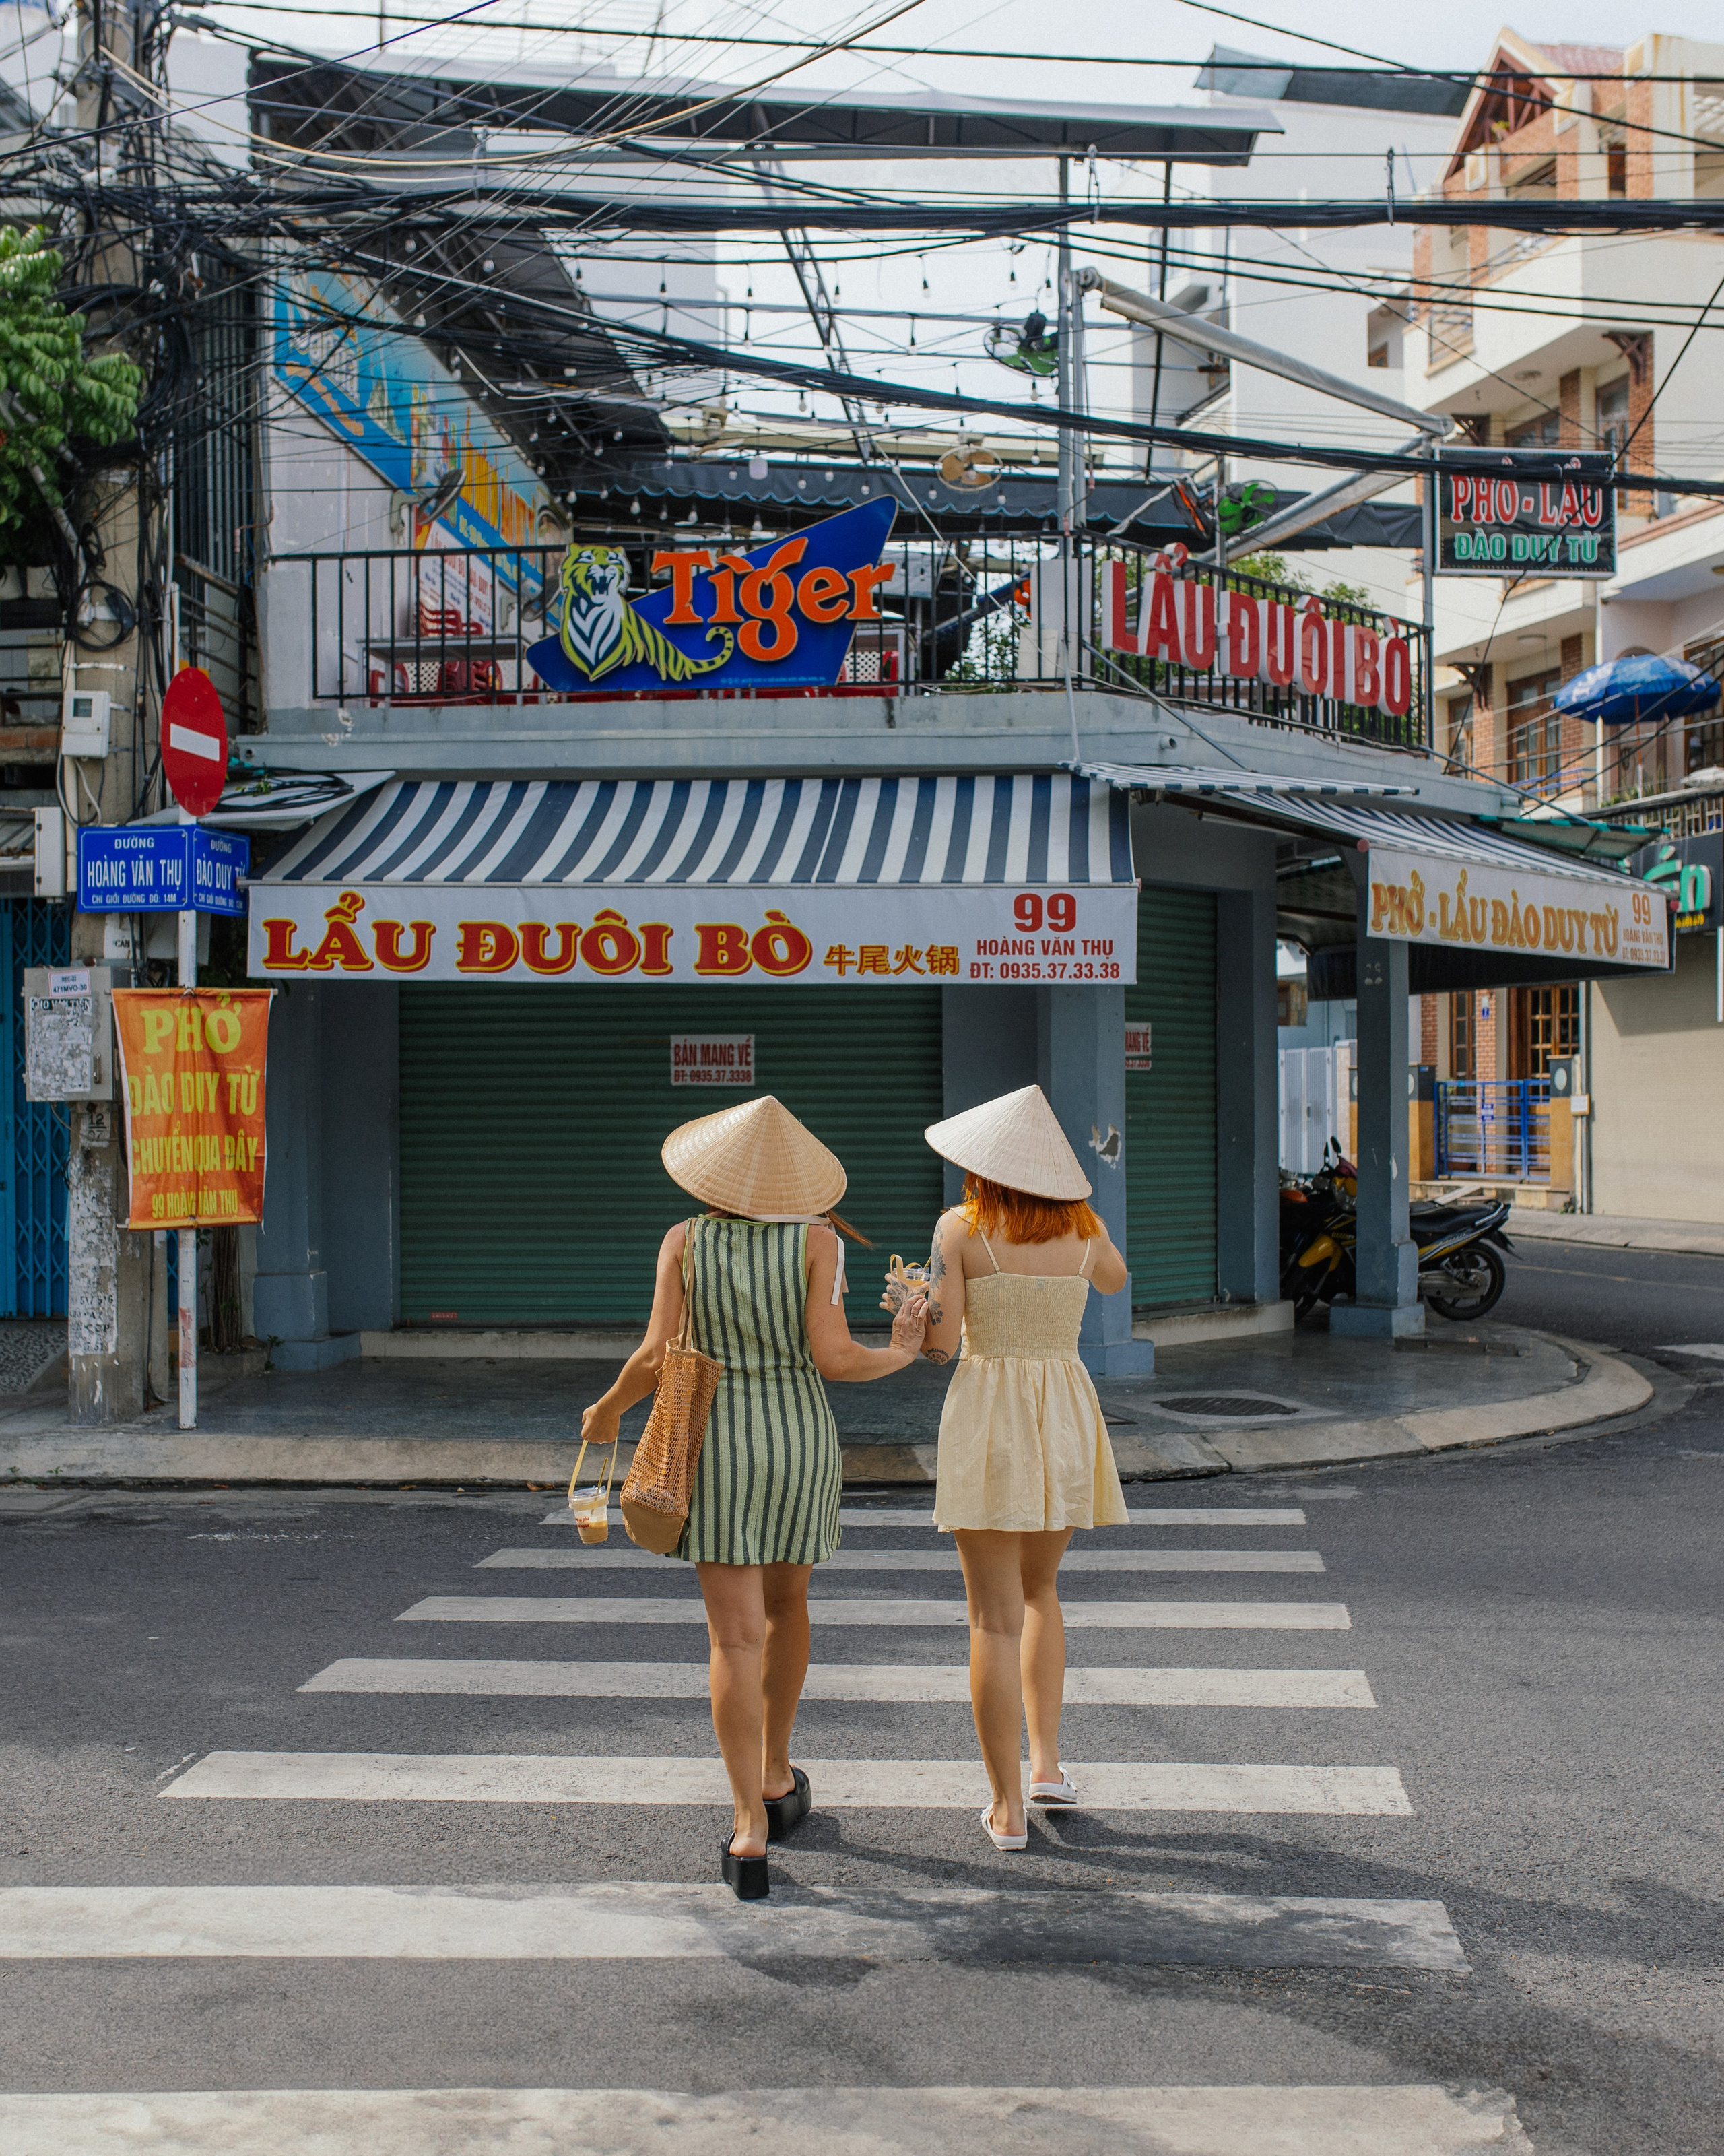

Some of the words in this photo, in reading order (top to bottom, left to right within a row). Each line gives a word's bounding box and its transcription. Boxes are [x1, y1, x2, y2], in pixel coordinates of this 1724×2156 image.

[1454, 527, 1507, 561] ĐÀO
[1512, 533, 1562, 562] DUY
[1566, 530, 1601, 564] TỪ
[651, 537, 896, 661] Tiger
[1102, 542, 1214, 670] LẨU
[1216, 595, 1346, 700] ĐUÔI
[1346, 616, 1411, 717] BÒ
[114, 835, 154, 849] ĐƯỜNG
[87, 855, 126, 888] HOÀNG
[131, 854, 154, 886] VĂN
[160, 858, 183, 891] THỤ
[197, 853, 213, 888] ĐÀO
[216, 862, 232, 890] DUY
[164, 893, 176, 903] 14M
[1013, 892, 1077, 933] 99
[1371, 869, 1425, 937] PHỞ
[1438, 868, 1488, 943] LẨU
[1491, 889, 1541, 949] ĐÀO
[1542, 905, 1587, 954] DUY
[1589, 903, 1618, 957] TỪ
[1632, 892, 1651, 925] 99
[261, 890, 436, 973] LẨU
[455, 907, 674, 975] ĐUÔI
[694, 909, 812, 977] BÒ
[976, 938, 1035, 956] HOÀNG
[1040, 936, 1075, 956] VĂN
[1081, 940, 1113, 960] THỤ
[824, 944, 960, 976] 牛尾火锅
[970, 963, 995, 979] ĐT:
[999, 962, 1121, 979] 0935.37.33.38
[140, 992, 242, 1053] PHỞ
[674, 1038, 697, 1066] BÁN
[700, 1043, 735, 1066] MANG
[127, 1065, 174, 1117] ĐÀO
[180, 1072, 220, 1113] DUY
[227, 1065, 261, 1116] TỪ
[90, 1113, 104, 1125] 12
[131, 1120, 193, 1175] CHUYỂN
[194, 1134, 221, 1177] QUA
[225, 1128, 258, 1172] ĐÂY
[152, 1193, 165, 1219] 99
[219, 1189, 238, 1219] THỤ
